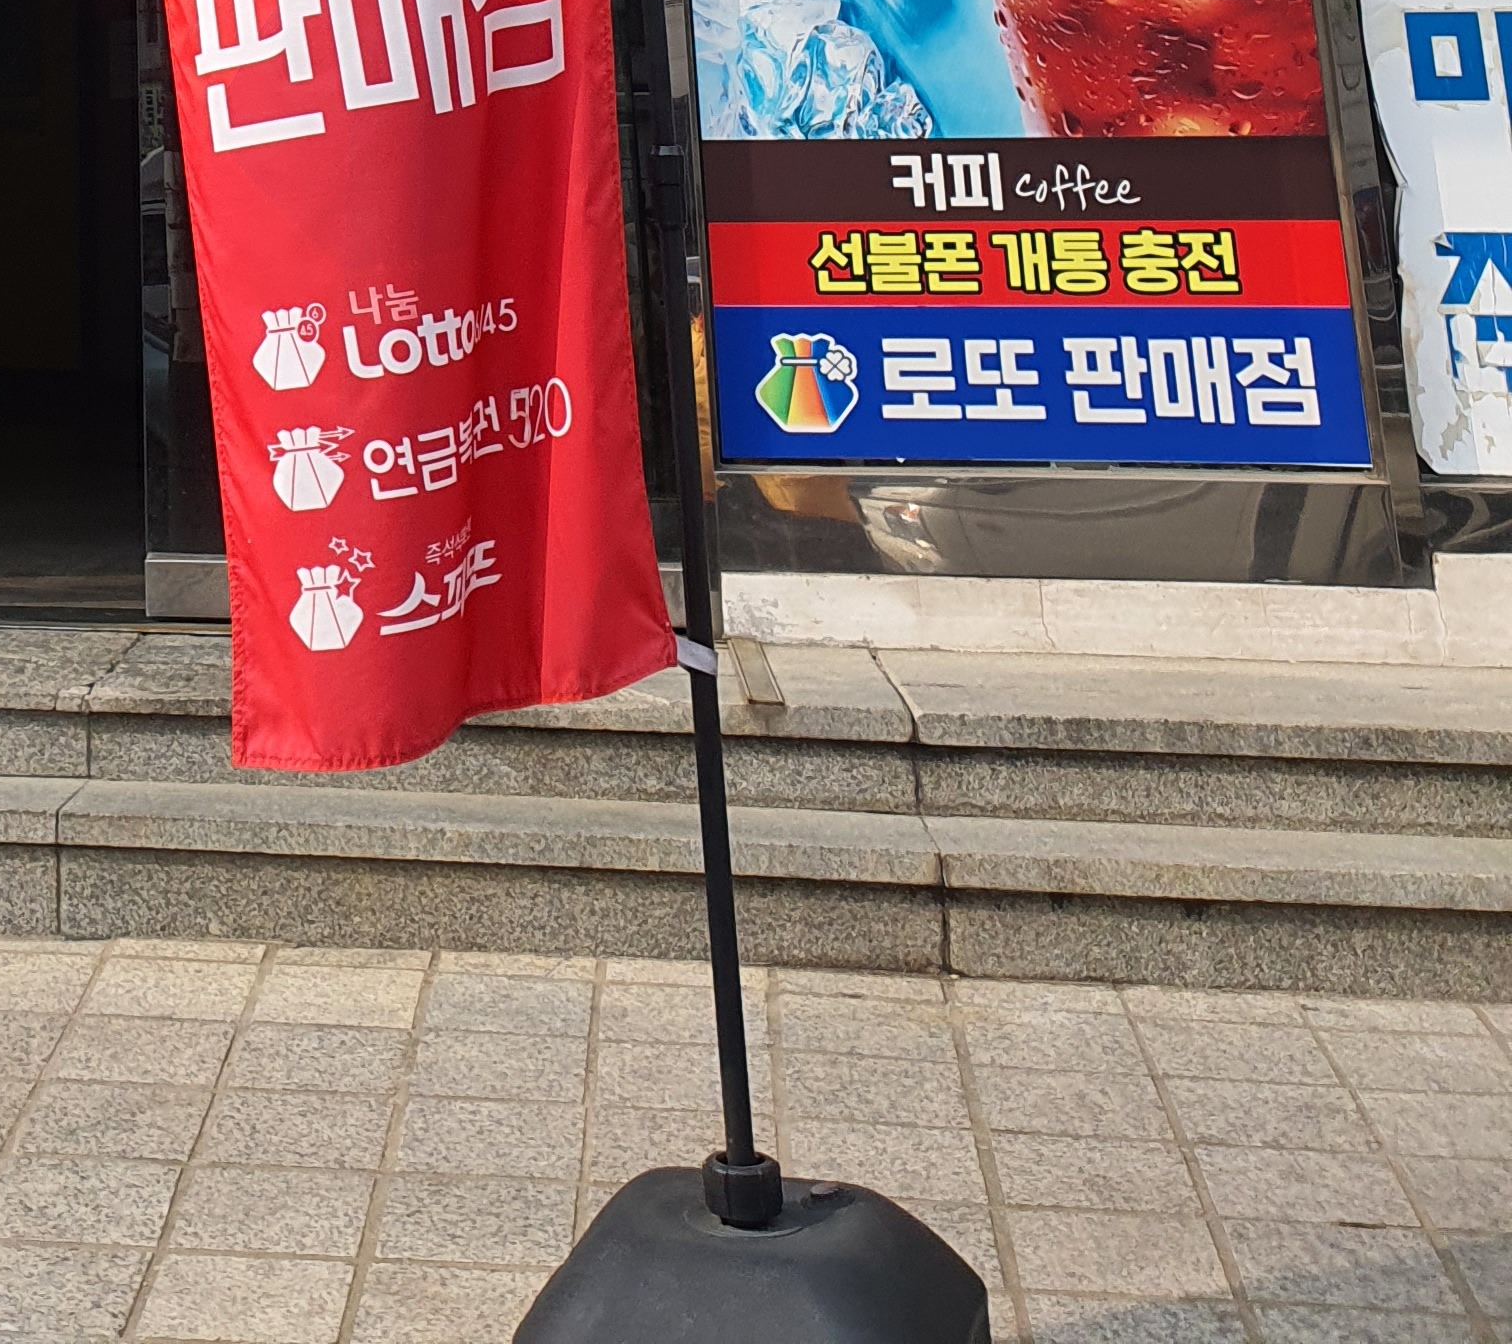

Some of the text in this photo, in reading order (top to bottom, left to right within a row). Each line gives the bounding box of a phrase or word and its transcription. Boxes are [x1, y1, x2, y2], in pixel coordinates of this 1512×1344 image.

[889, 153, 1143, 212] 커피 coffee
[808, 229, 1243, 296] 선불폰 개통 충전
[348, 283, 420, 325] 나눔
[881, 335, 1321, 427] 로또 판매점
[376, 539, 503, 637] 스피또
